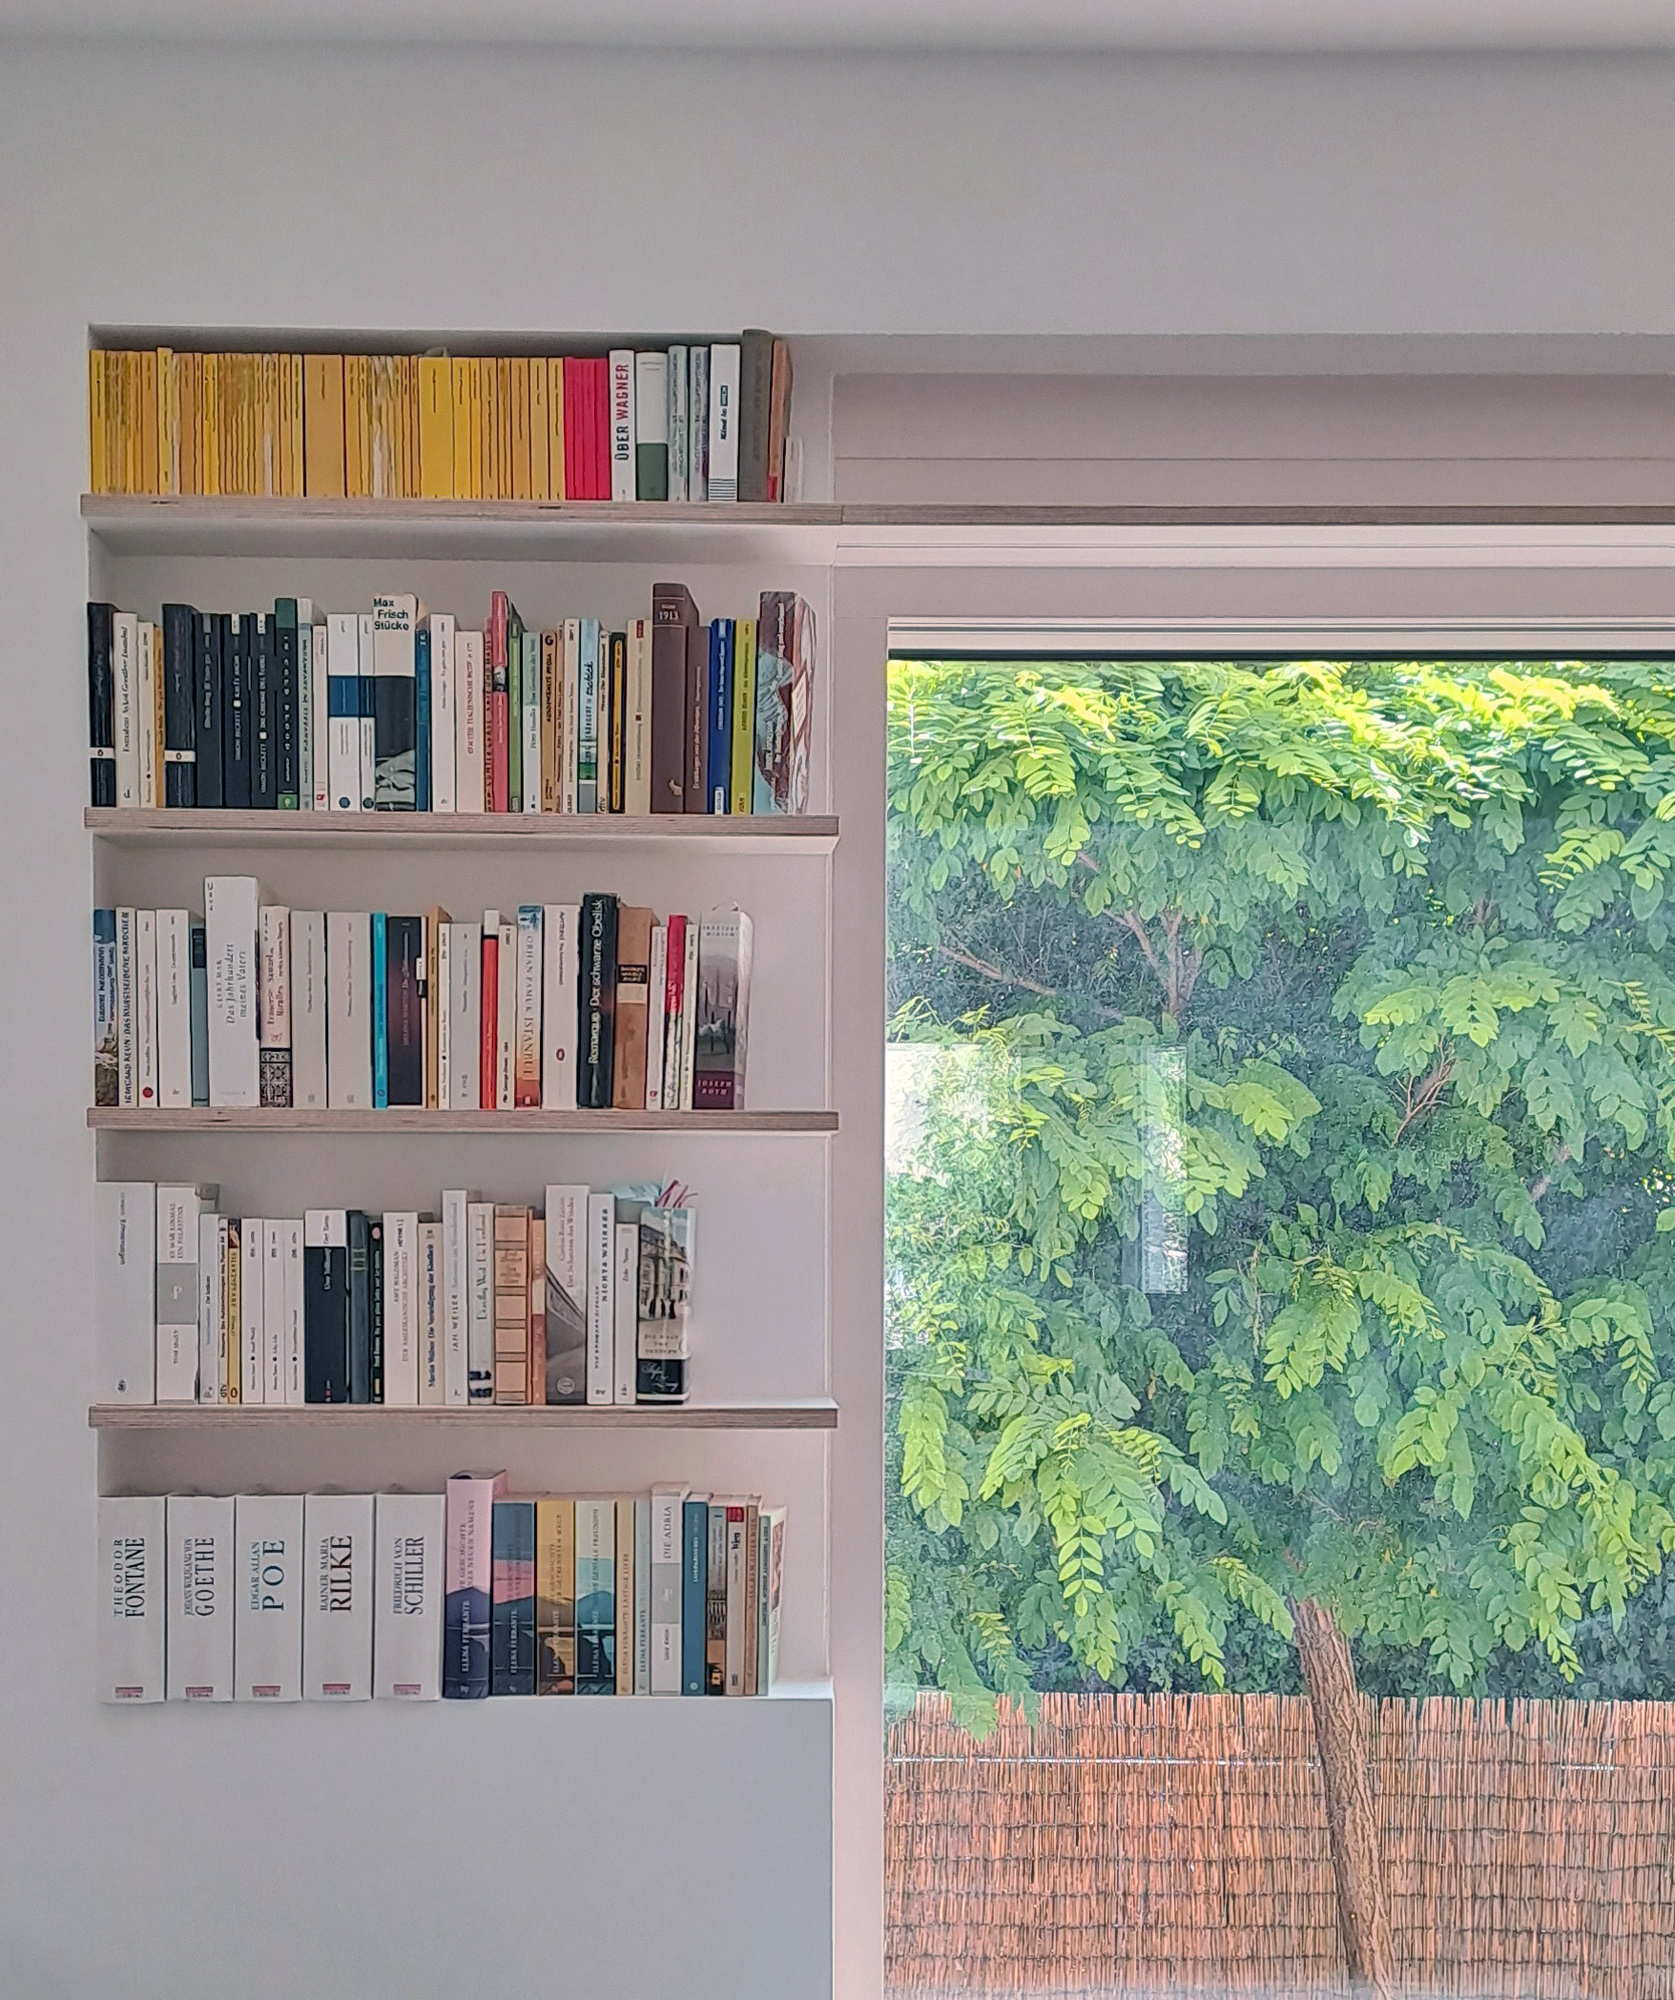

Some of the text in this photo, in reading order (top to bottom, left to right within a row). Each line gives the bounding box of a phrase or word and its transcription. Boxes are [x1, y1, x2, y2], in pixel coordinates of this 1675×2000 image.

[614, 364, 630, 460] ÜBER WAGNER
[374, 598, 394, 608] Max
[374, 620, 409, 630] Stücke
[378, 608, 409, 620] Frisch
[658, 611, 680, 620] 1913
[282, 658, 290, 695] COLD
[224, 943, 236, 1024] Das Jahrhundert
[526, 935, 534, 973] ORHAN
[588, 899, 603, 1064] Remarque Der schwarze Obelisk
[122, 1018, 132, 1034] DAS
[238, 984, 247, 1018] meines
[122, 1039, 132, 1062] KEUN
[523, 1017, 534, 1076] ISTANBUL
[123, 1064, 132, 1104] IRMGARD
[663, 1506, 672, 1559] DIE ADRIA
[114, 1539, 123, 1616] THEODOR
[125, 1538, 145, 1618] FONTANE
[184, 1538, 194, 1616] JOHANN WOLFGANG VON
[195, 1538, 214, 1616] GOETHE
[251, 1542, 260, 1610] EDGAR ALLAN
[262, 1540, 284, 1611] POE
[320, 1538, 328, 1611] RAINER MARIA
[330, 1536, 352, 1612] RILKE
[393, 1538, 402, 1614] FRIEDRICH VON
[404, 1536, 424, 1615] SCHILLER
[462, 1600, 470, 1672] ELENA FERRANTE
